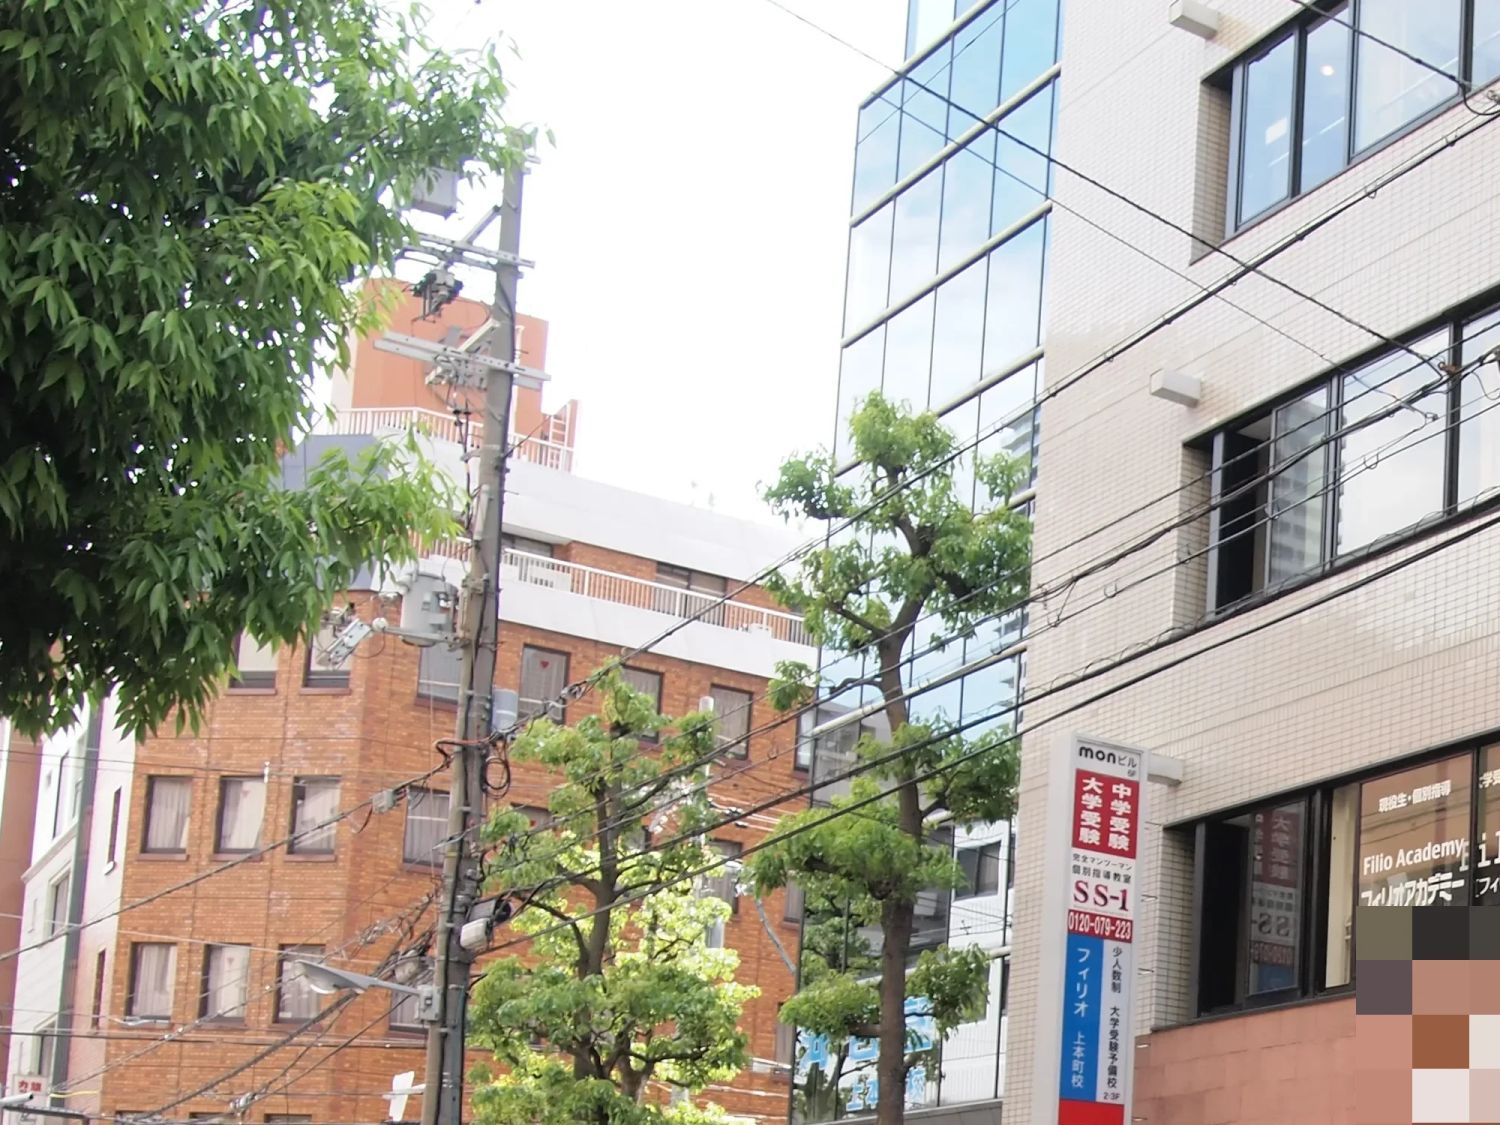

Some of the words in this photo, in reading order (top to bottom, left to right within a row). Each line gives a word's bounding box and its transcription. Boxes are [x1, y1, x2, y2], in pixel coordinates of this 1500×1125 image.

[1078, 777, 1104, 846] 大学受験
[1108, 783, 1132, 852] 中学受験
[1072, 852, 1134, 872] 完全マンツーマン
[1363, 852, 1393, 876] Filio
[1395, 837, 1466, 868] Academy
[1068, 911, 1132, 940] 0120-079-223
[1073, 948, 1091, 1018] フィリオ
[1110, 946, 1123, 994] 少人数制
[1070, 1031, 1086, 1089] 上本町校
[1106, 1005, 1121, 1089] 大学受験予備校
